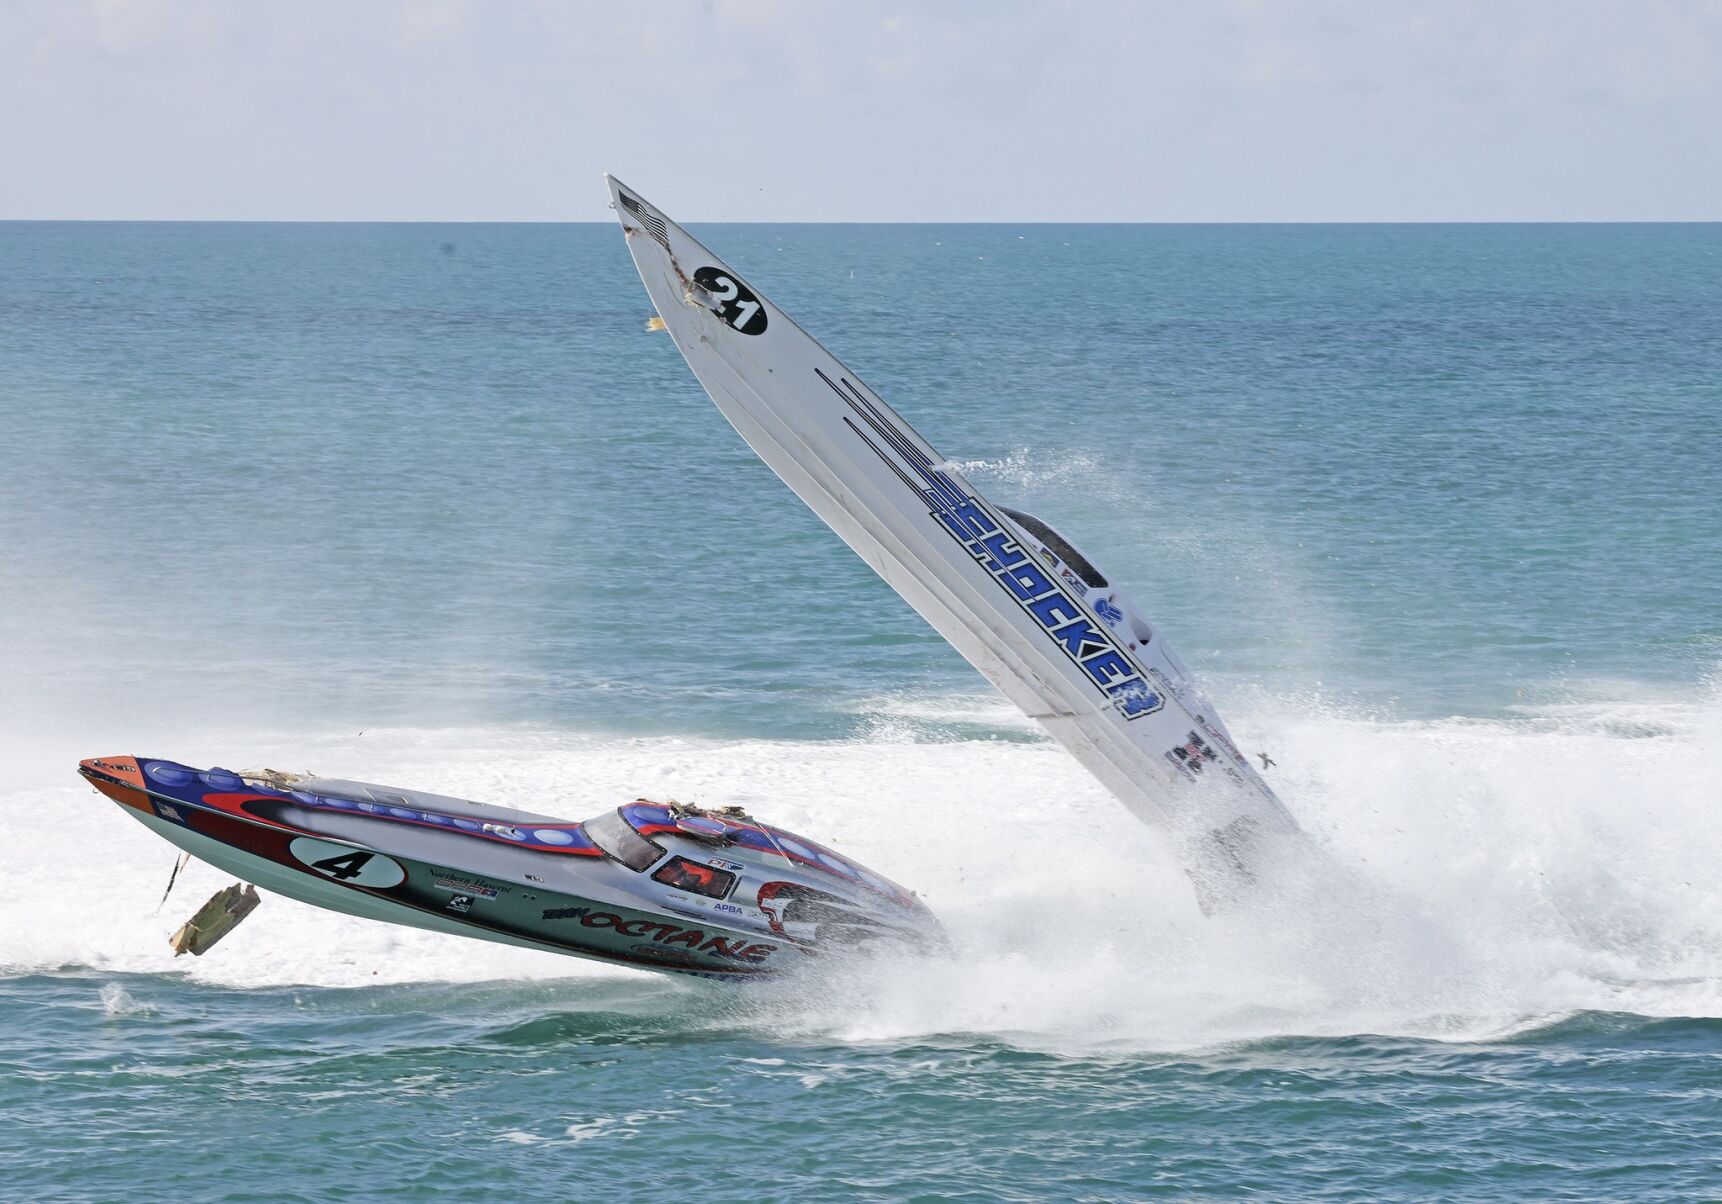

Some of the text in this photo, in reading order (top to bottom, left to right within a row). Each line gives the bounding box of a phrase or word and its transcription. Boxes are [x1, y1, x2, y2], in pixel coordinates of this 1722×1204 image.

[712, 275, 761, 330] 21
[927, 493, 1167, 721] SHOCKER
[311, 851, 375, 880] 4
[714, 903, 743, 914] APBA
[580, 912, 778, 963] OCTANE
